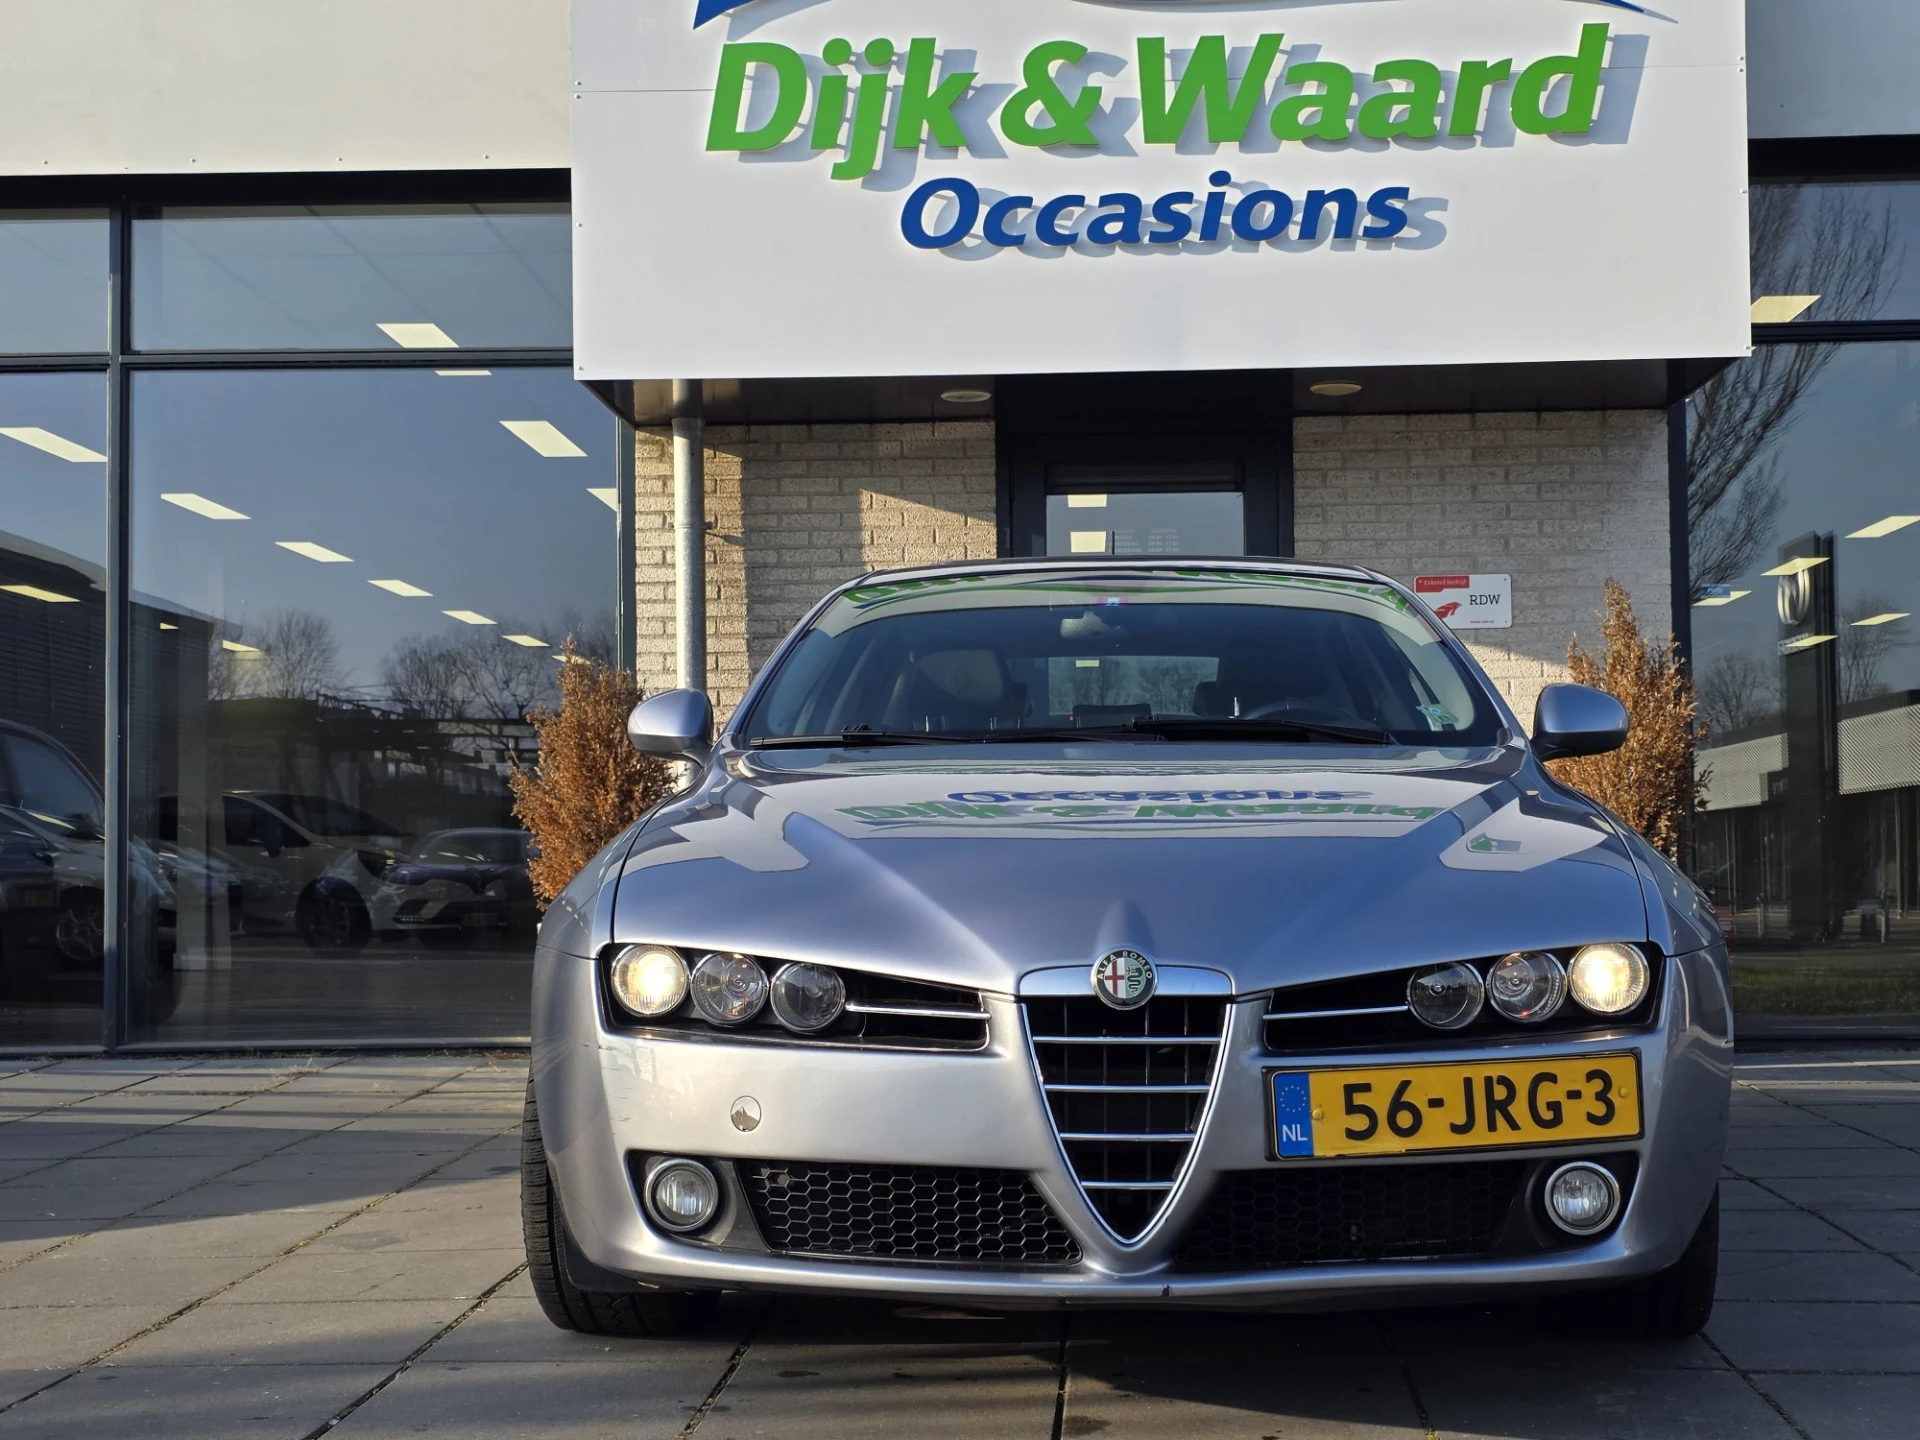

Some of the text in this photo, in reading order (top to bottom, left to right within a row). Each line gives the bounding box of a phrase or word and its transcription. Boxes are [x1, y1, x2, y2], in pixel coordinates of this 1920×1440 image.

[706, 23, 1610, 180] Dijk & Waard
[900, 169, 1410, 249] Occasions
[1469, 594, 1500, 606] RDW
[1097, 951, 1153, 980] ALFA ROMEO
[1343, 1068, 1616, 1142] 56-JRG-3
[1282, 1124, 1308, 1142] NL
